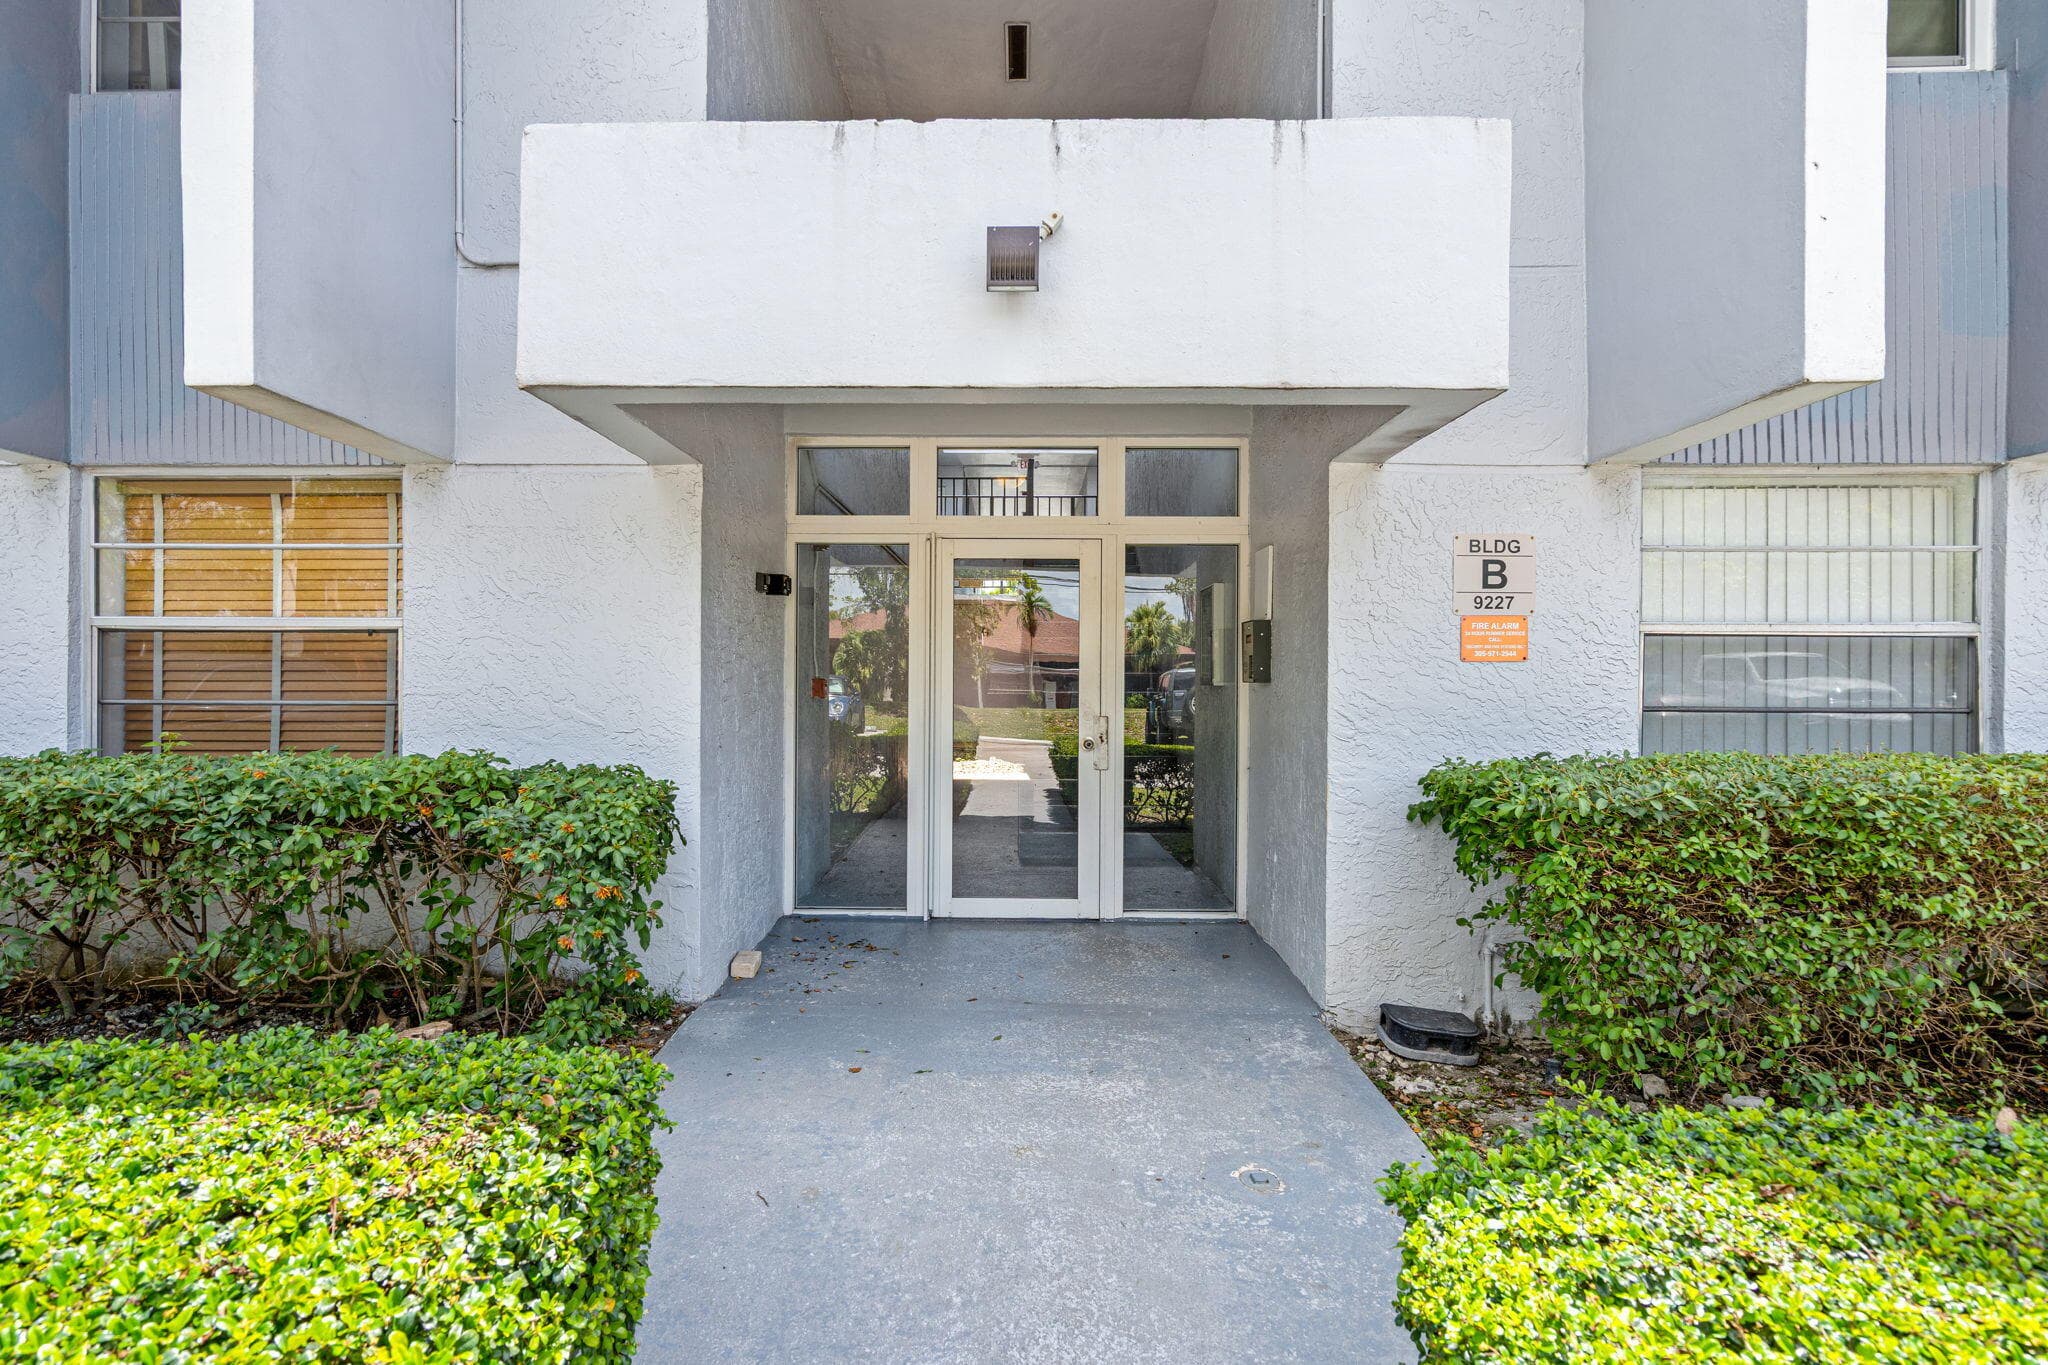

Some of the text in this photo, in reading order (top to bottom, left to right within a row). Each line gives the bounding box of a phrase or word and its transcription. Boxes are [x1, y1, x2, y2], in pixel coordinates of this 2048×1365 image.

[1469, 539, 1521, 553] BLDG
[1482, 559, 1508, 589] B
[1473, 595, 1515, 610] 9227
[1471, 622, 1520, 630] FIRE ALARM
